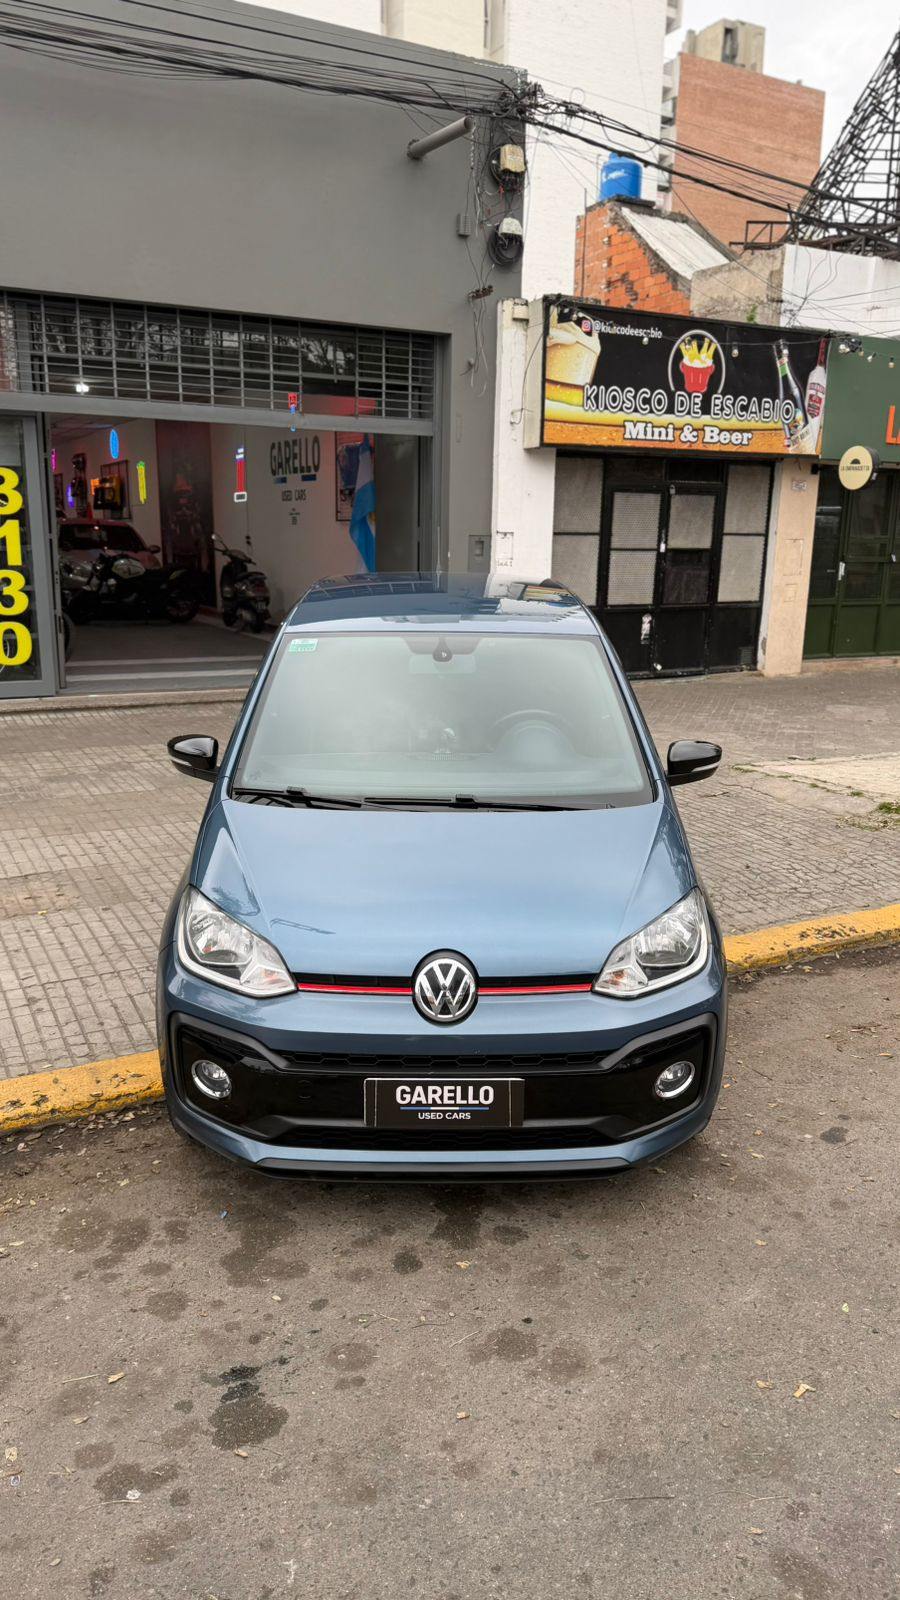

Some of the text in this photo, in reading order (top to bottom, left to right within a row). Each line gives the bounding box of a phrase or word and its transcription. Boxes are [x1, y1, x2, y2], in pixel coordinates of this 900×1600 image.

[583, 385, 668, 415] KIOSCO
[674, 391, 702, 417] DE
[710, 394, 795, 423] ESCABIO
[623, 420, 753, 446] Mini & Beer
[886, 405, 900, 444] L
[270, 435, 320, 476] GARELLO
[395, 1085, 495, 1105] GARELLO
[418, 1112, 472, 1120] USED CARS
